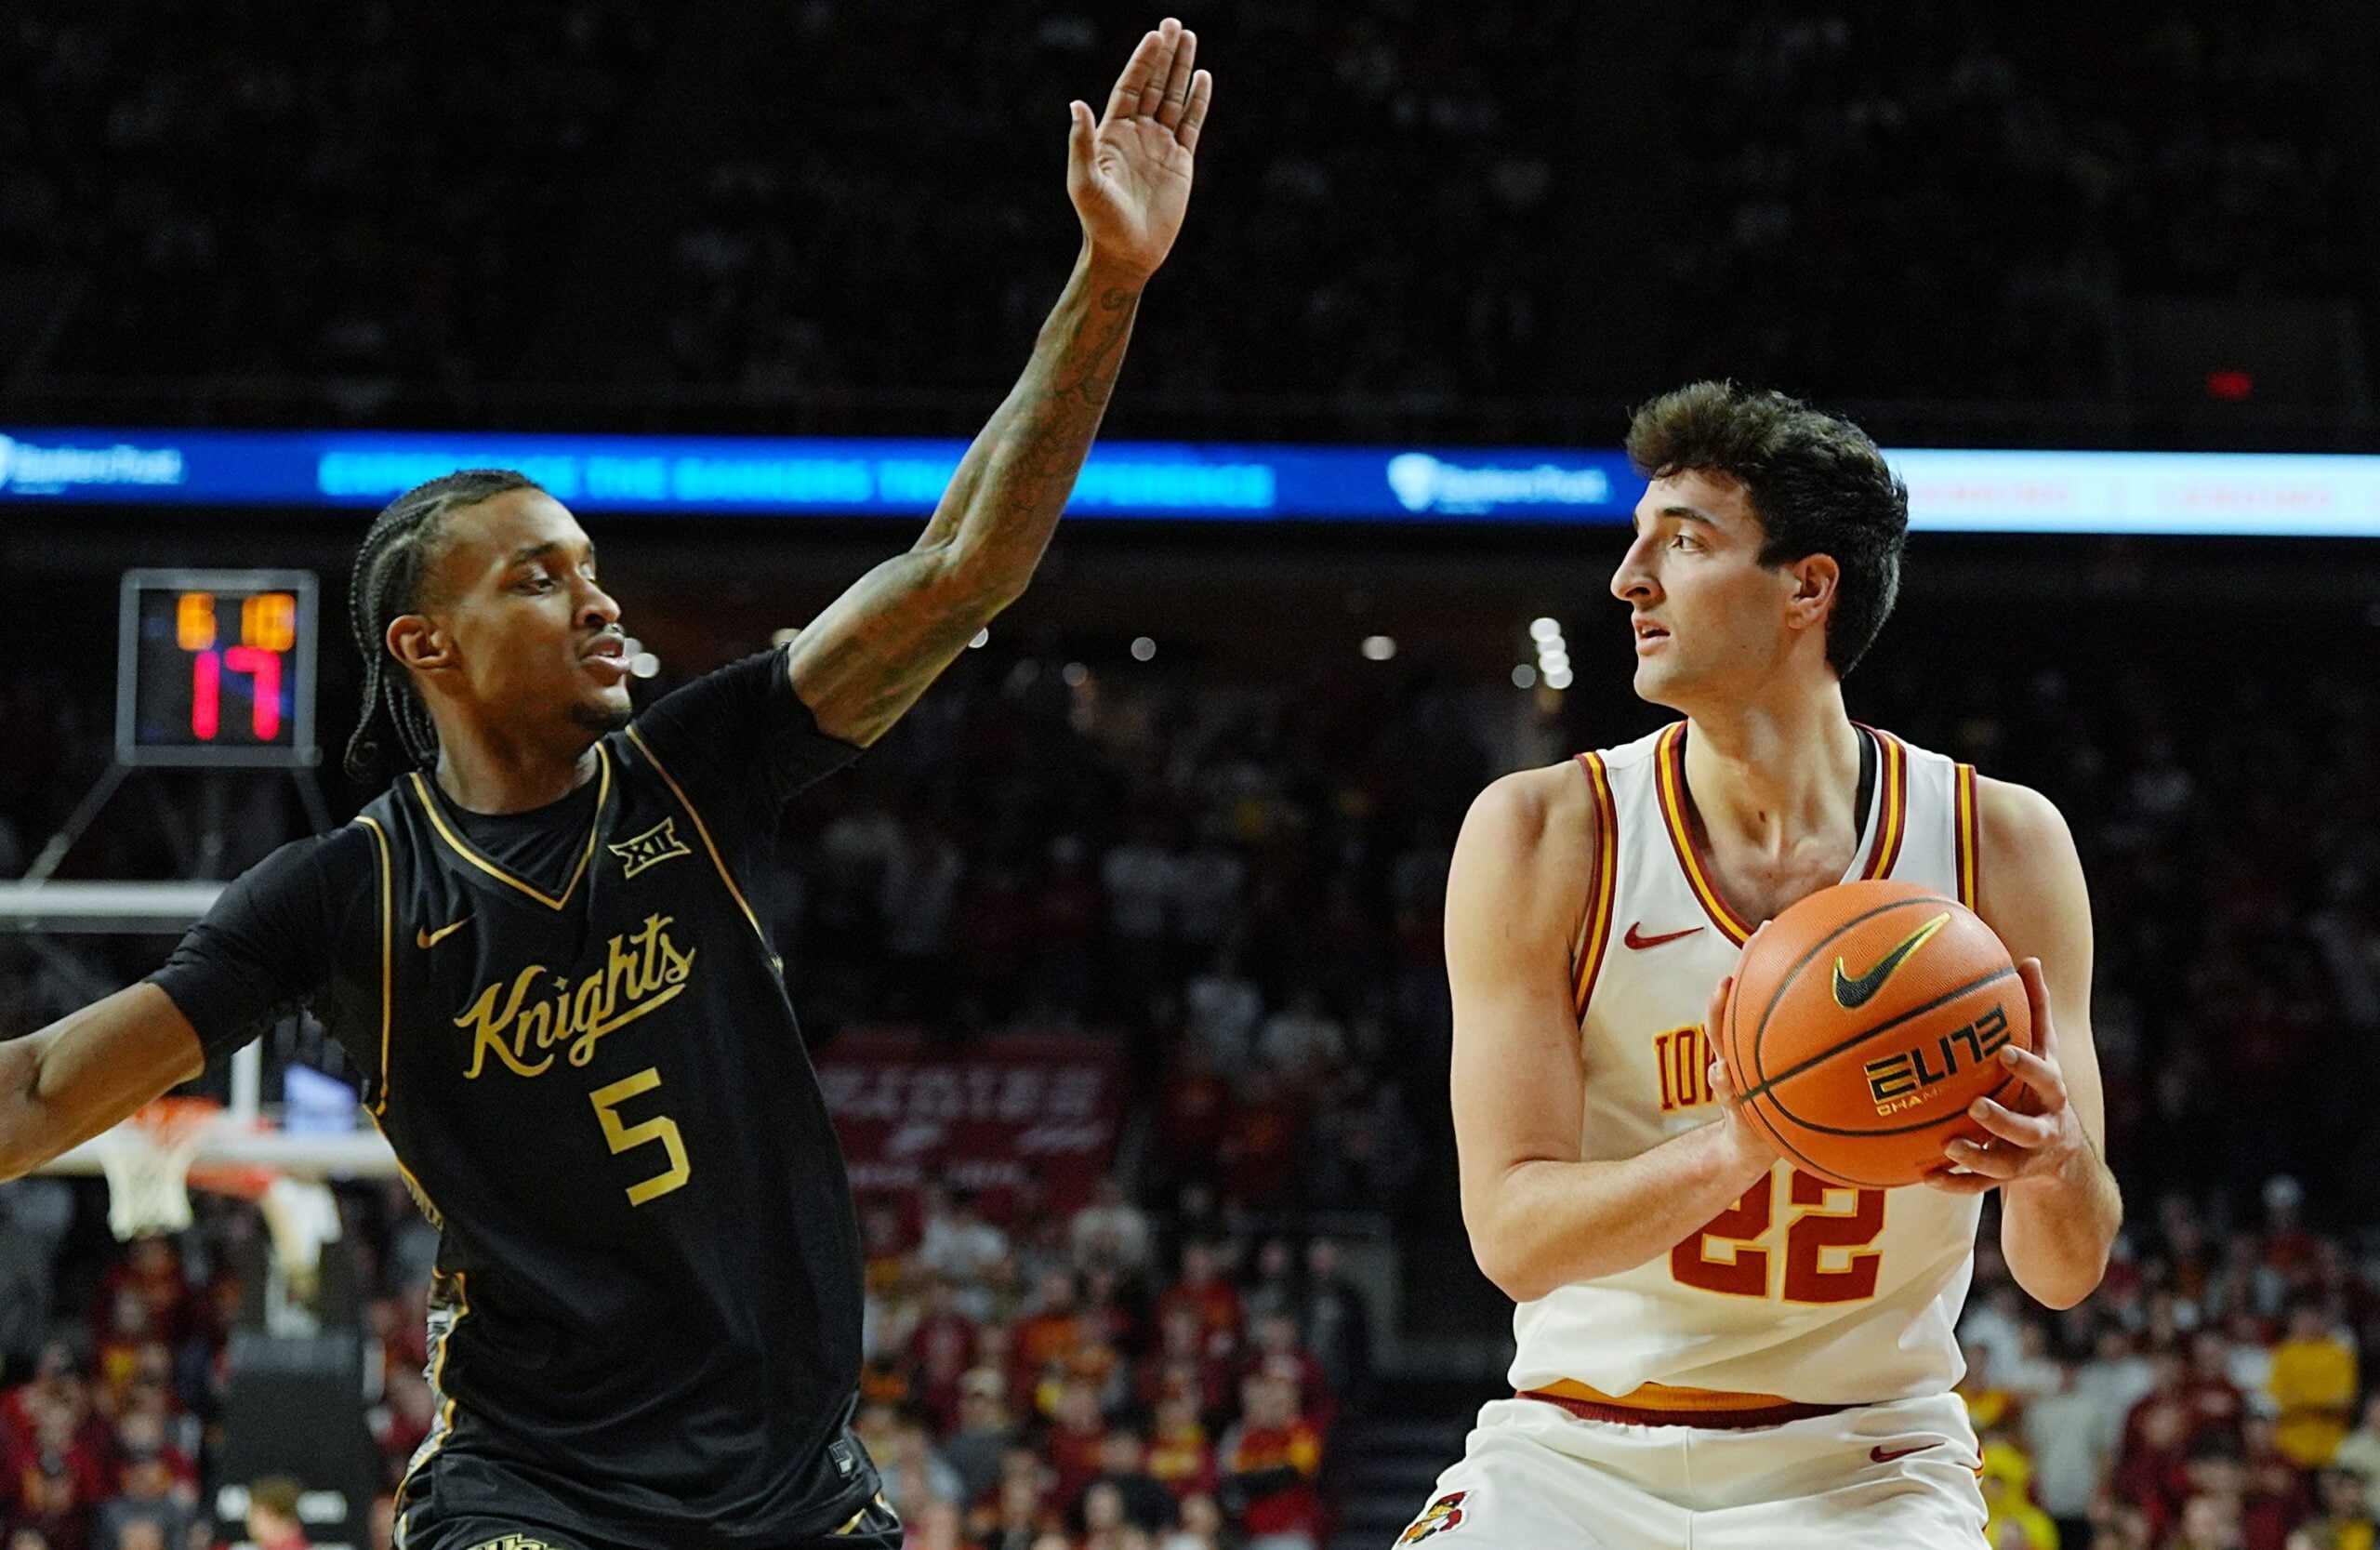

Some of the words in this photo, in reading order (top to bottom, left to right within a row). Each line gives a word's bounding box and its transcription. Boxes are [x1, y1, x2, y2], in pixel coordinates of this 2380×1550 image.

[192, 645, 282, 741] 17
[453, 913, 695, 1079] Knights
[588, 1066, 691, 1207] 5
[1669, 1167, 1886, 1306] 22
